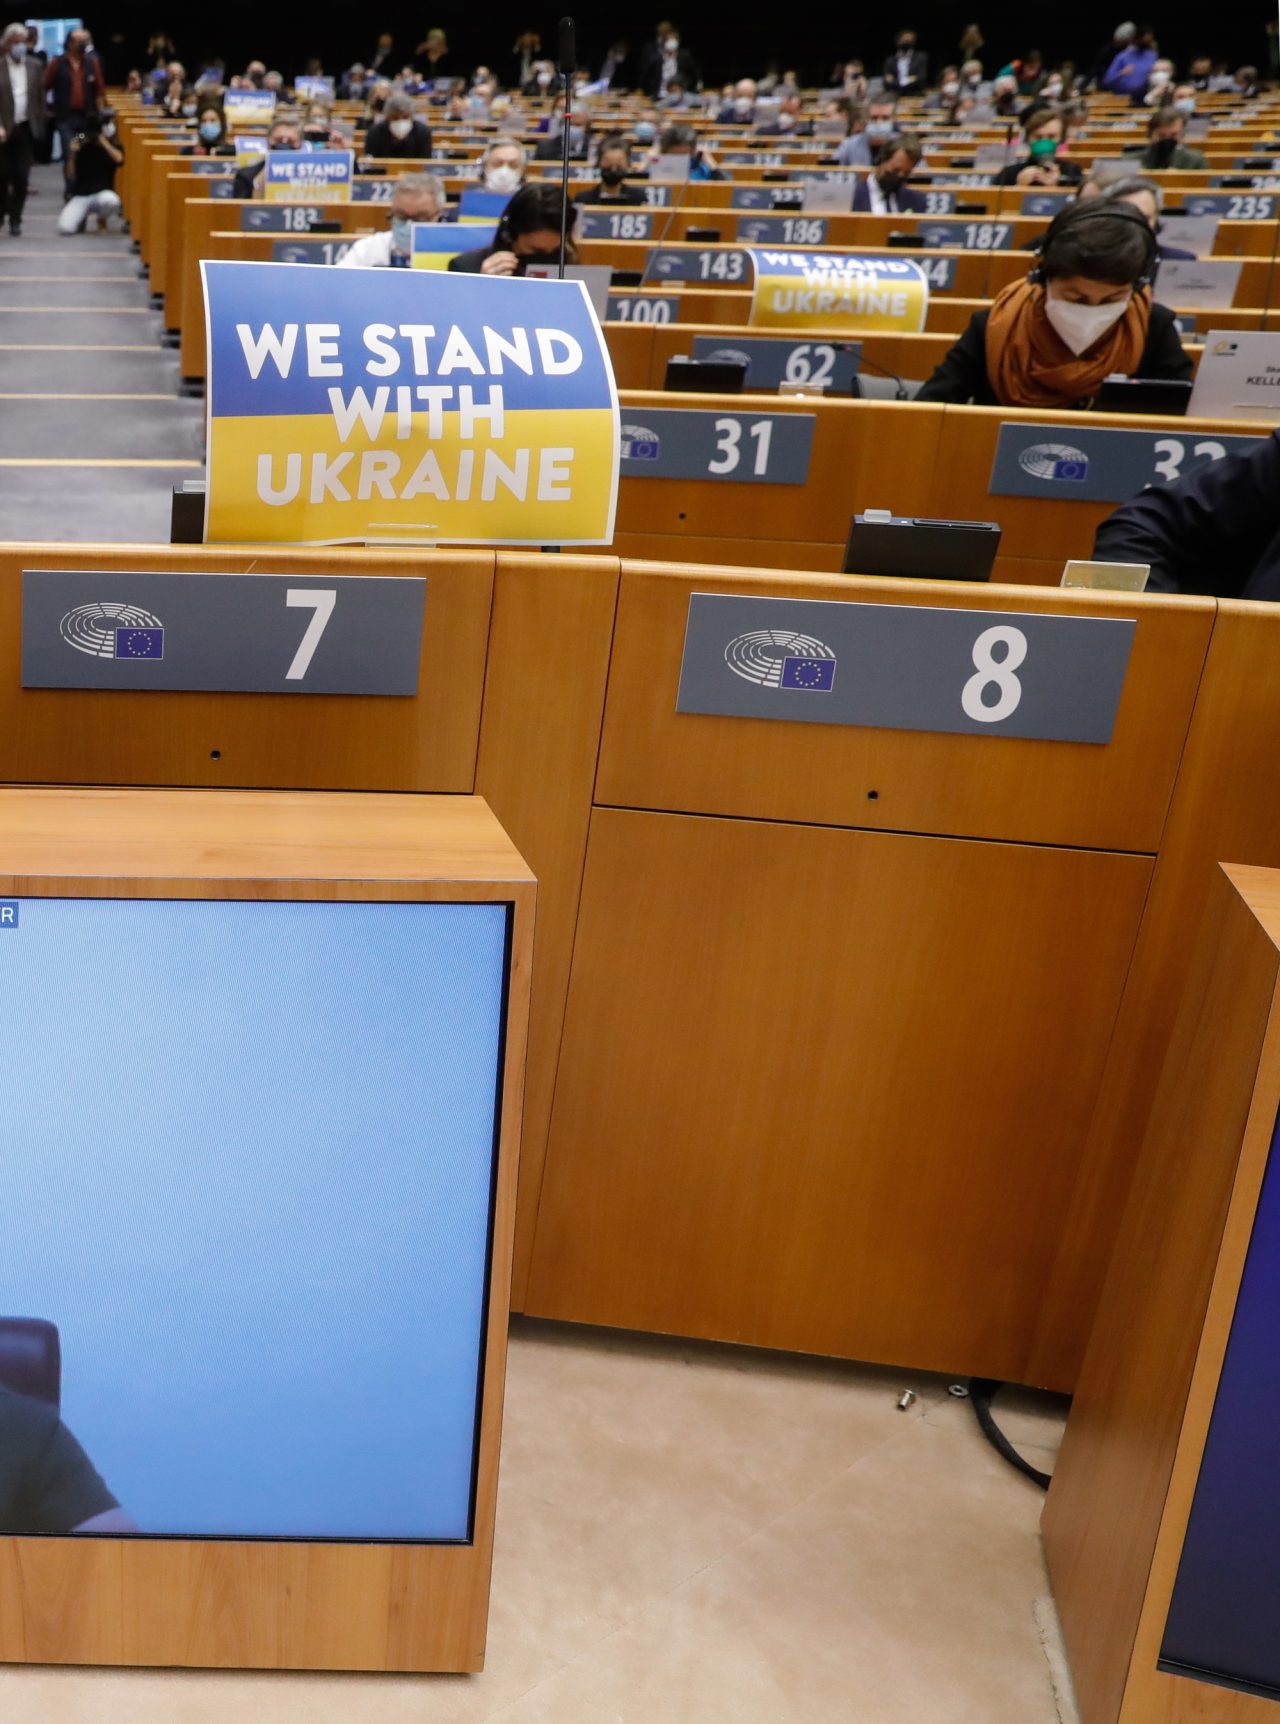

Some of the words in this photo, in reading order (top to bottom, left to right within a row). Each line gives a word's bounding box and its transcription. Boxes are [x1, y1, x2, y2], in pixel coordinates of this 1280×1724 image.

[1227, 196, 1271, 219] 235
[610, 214, 648, 239] 185
[783, 219, 823, 244] 186
[965, 224, 1008, 250] 187
[699, 252, 743, 281] 143
[761, 252, 809, 268] WE
[812, 256, 910, 274] STAND
[802, 269, 878, 290] WITH
[772, 289, 908, 316] UKRAINE
[236, 322, 344, 380] WE
[362, 324, 584, 377] STAND
[785, 345, 837, 387] 62
[327, 384, 505, 443] WITH
[707, 418, 774, 476] 31
[256, 447, 575, 506] UKRAINE
[284, 588, 337, 680] 7
[960, 625, 1029, 724] 8
